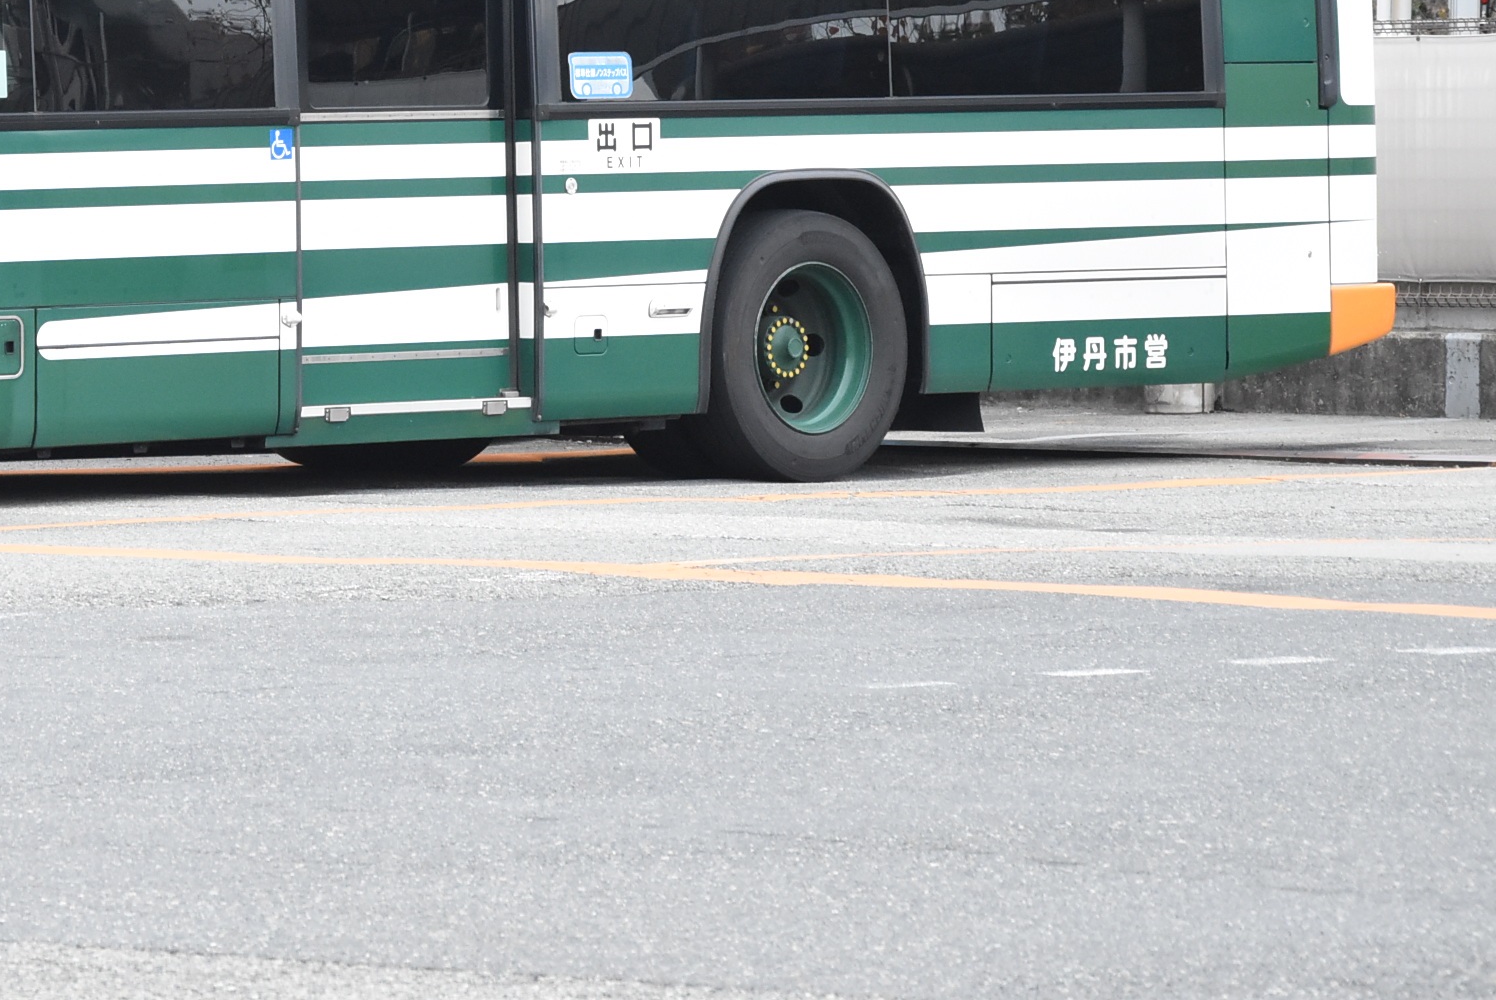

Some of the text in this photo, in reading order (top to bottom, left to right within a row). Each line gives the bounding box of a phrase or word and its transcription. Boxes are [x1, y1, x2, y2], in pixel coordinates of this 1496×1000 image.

[597, 122, 653, 152] 出口
[607, 156, 643, 168] EXIT
[1052, 334, 1168, 372] 伊丹市営
